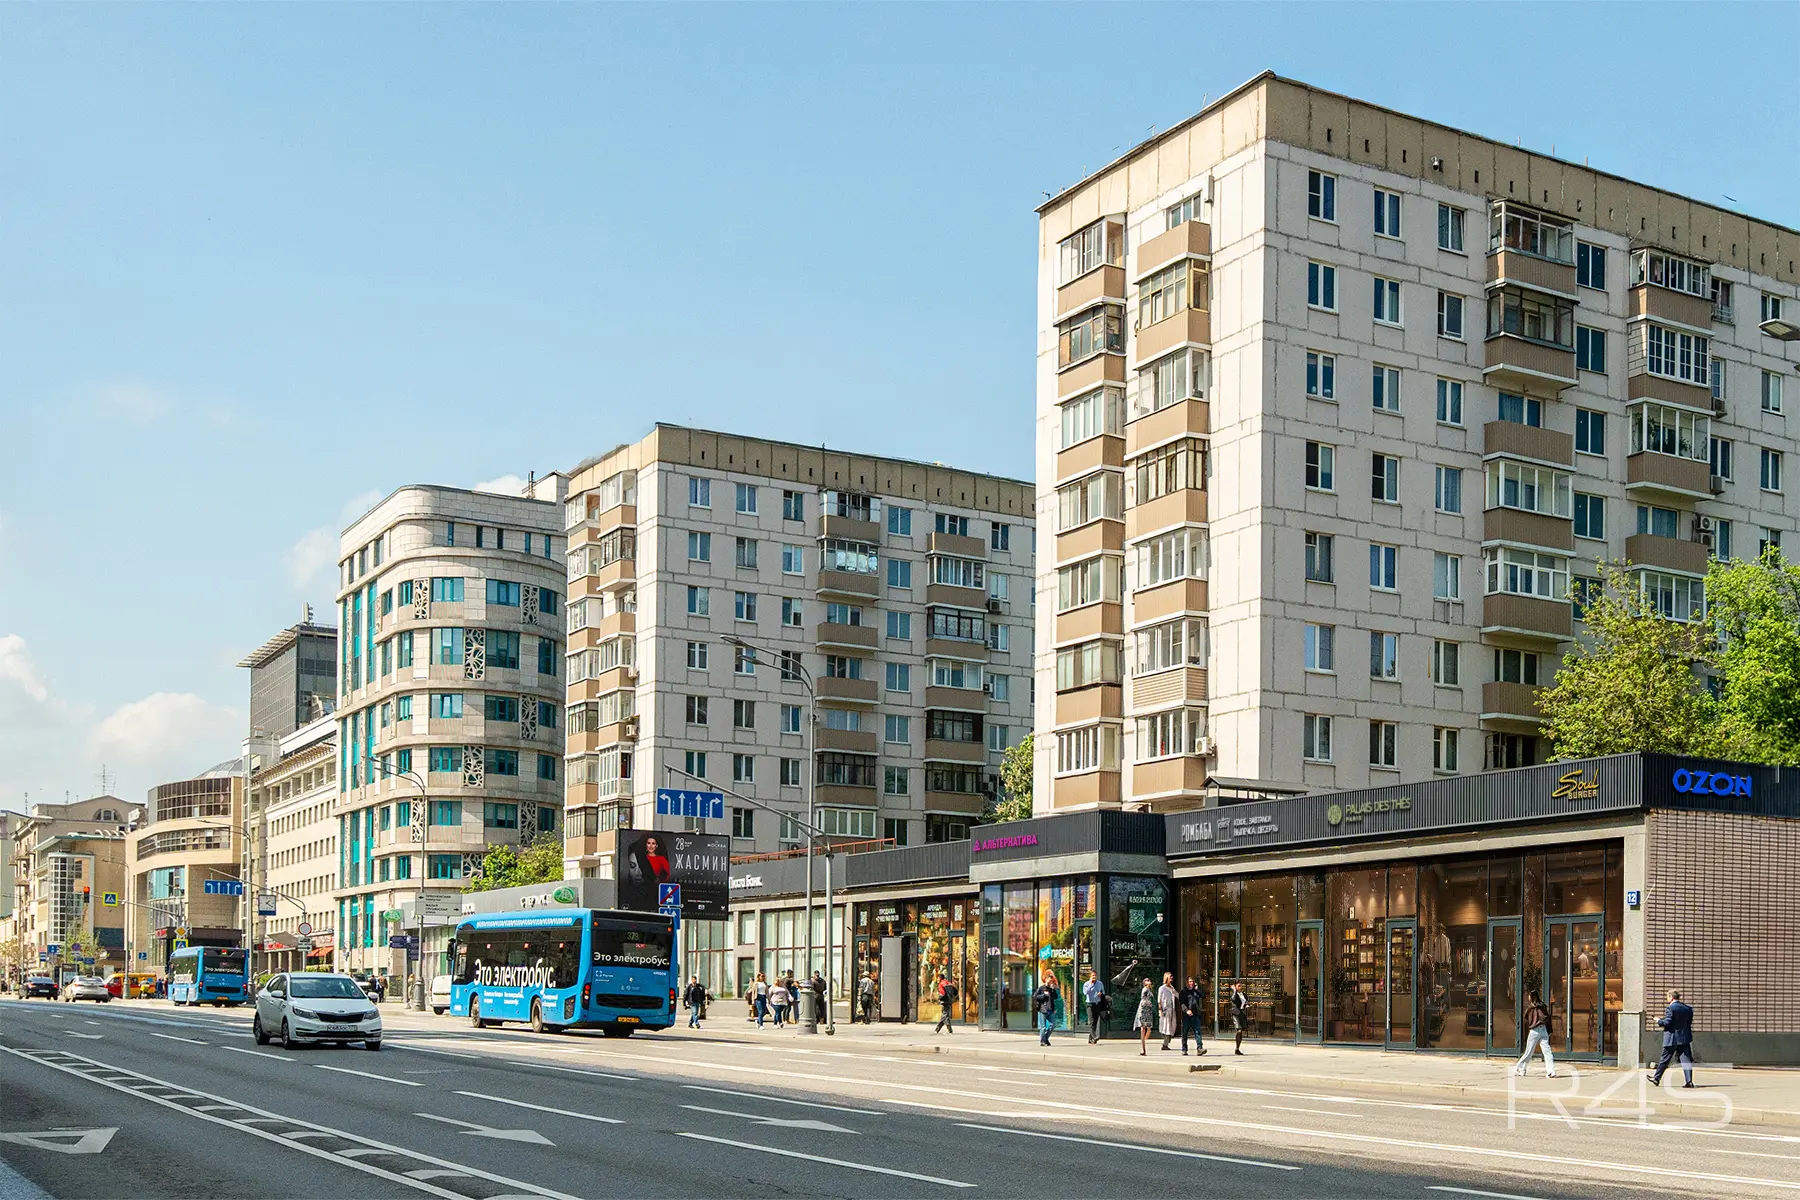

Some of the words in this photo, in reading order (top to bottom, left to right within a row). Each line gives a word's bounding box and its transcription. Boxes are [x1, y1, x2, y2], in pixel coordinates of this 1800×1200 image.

[1552, 768, 1600, 797] Soul
[1672, 768, 1752, 798] OZON
[1568, 789, 1597, 800] BURGER
[1345, 801, 1373, 815] PALAIS
[1374, 800, 1390, 812] DES
[1181, 822, 1212, 842] РОМБАБА
[675, 837, 685, 850] 28
[982, 834, 1038, 850] АЛЬТЕРНАТИВА
[675, 853, 727, 871] ЖАСМИН
[1627, 893, 1636, 902] 12
[593, 951, 612, 961] Это
[613, 955, 670, 967] электробус.
[474, 958, 492, 986] Это
[493, 958, 556, 995] электробус.
